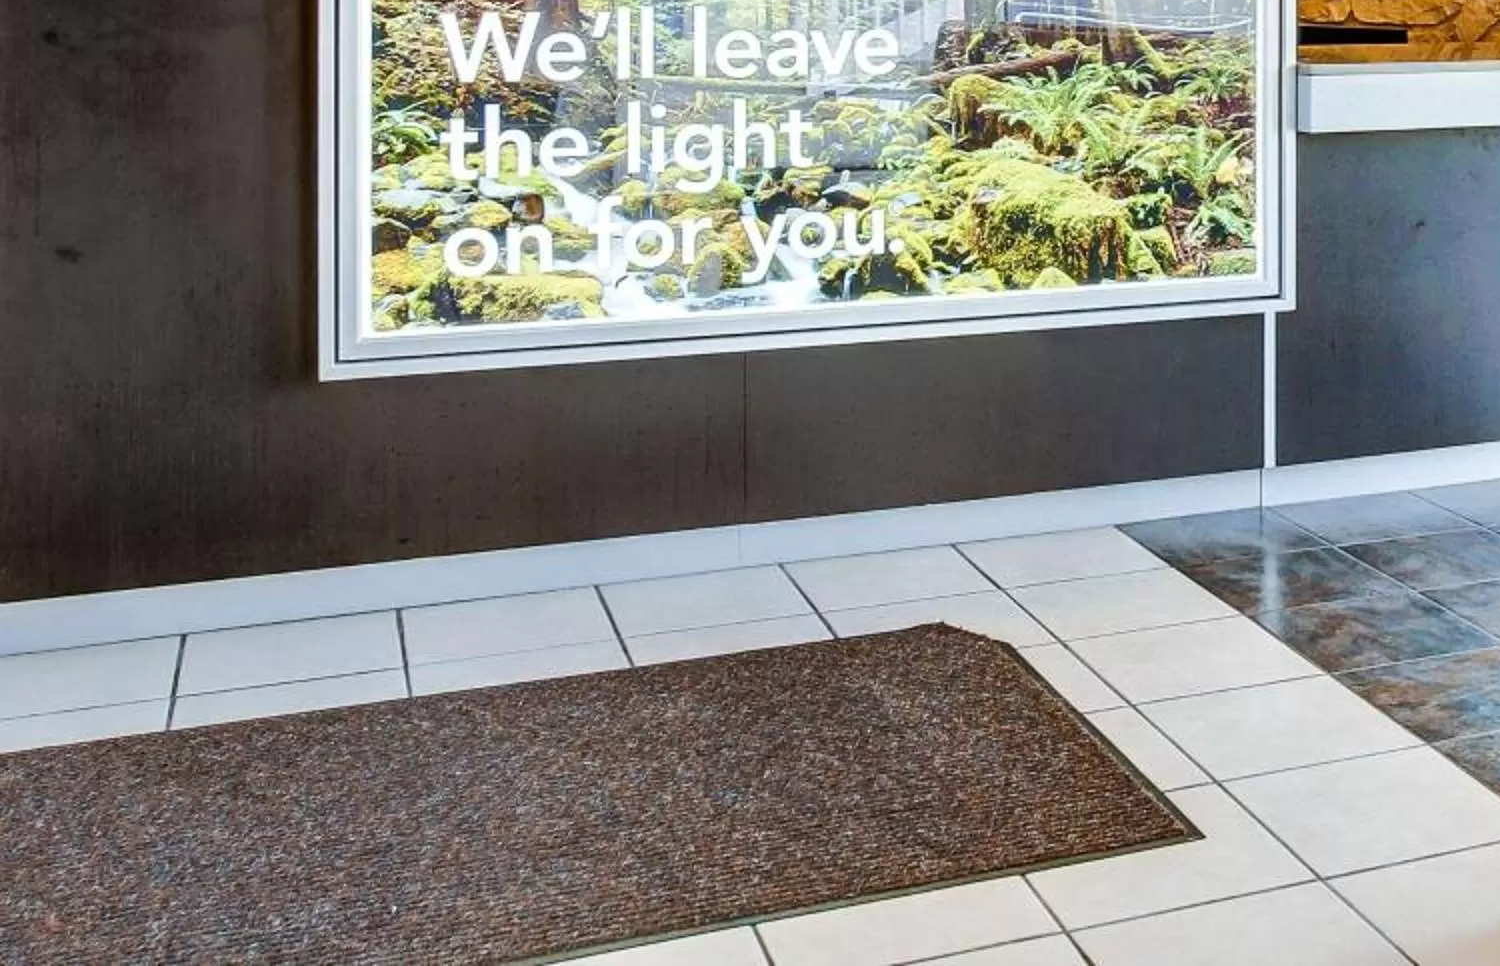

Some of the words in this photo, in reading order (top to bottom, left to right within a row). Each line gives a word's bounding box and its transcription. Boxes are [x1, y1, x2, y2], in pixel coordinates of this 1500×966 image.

[439, 6, 656, 83] We'll
[694, 6, 900, 79] leave
[440, 104, 589, 181] the
[627, 98, 814, 193] light
[443, 221, 554, 277] on
[589, 195, 713, 269] for
[740, 207, 906, 285] you.
